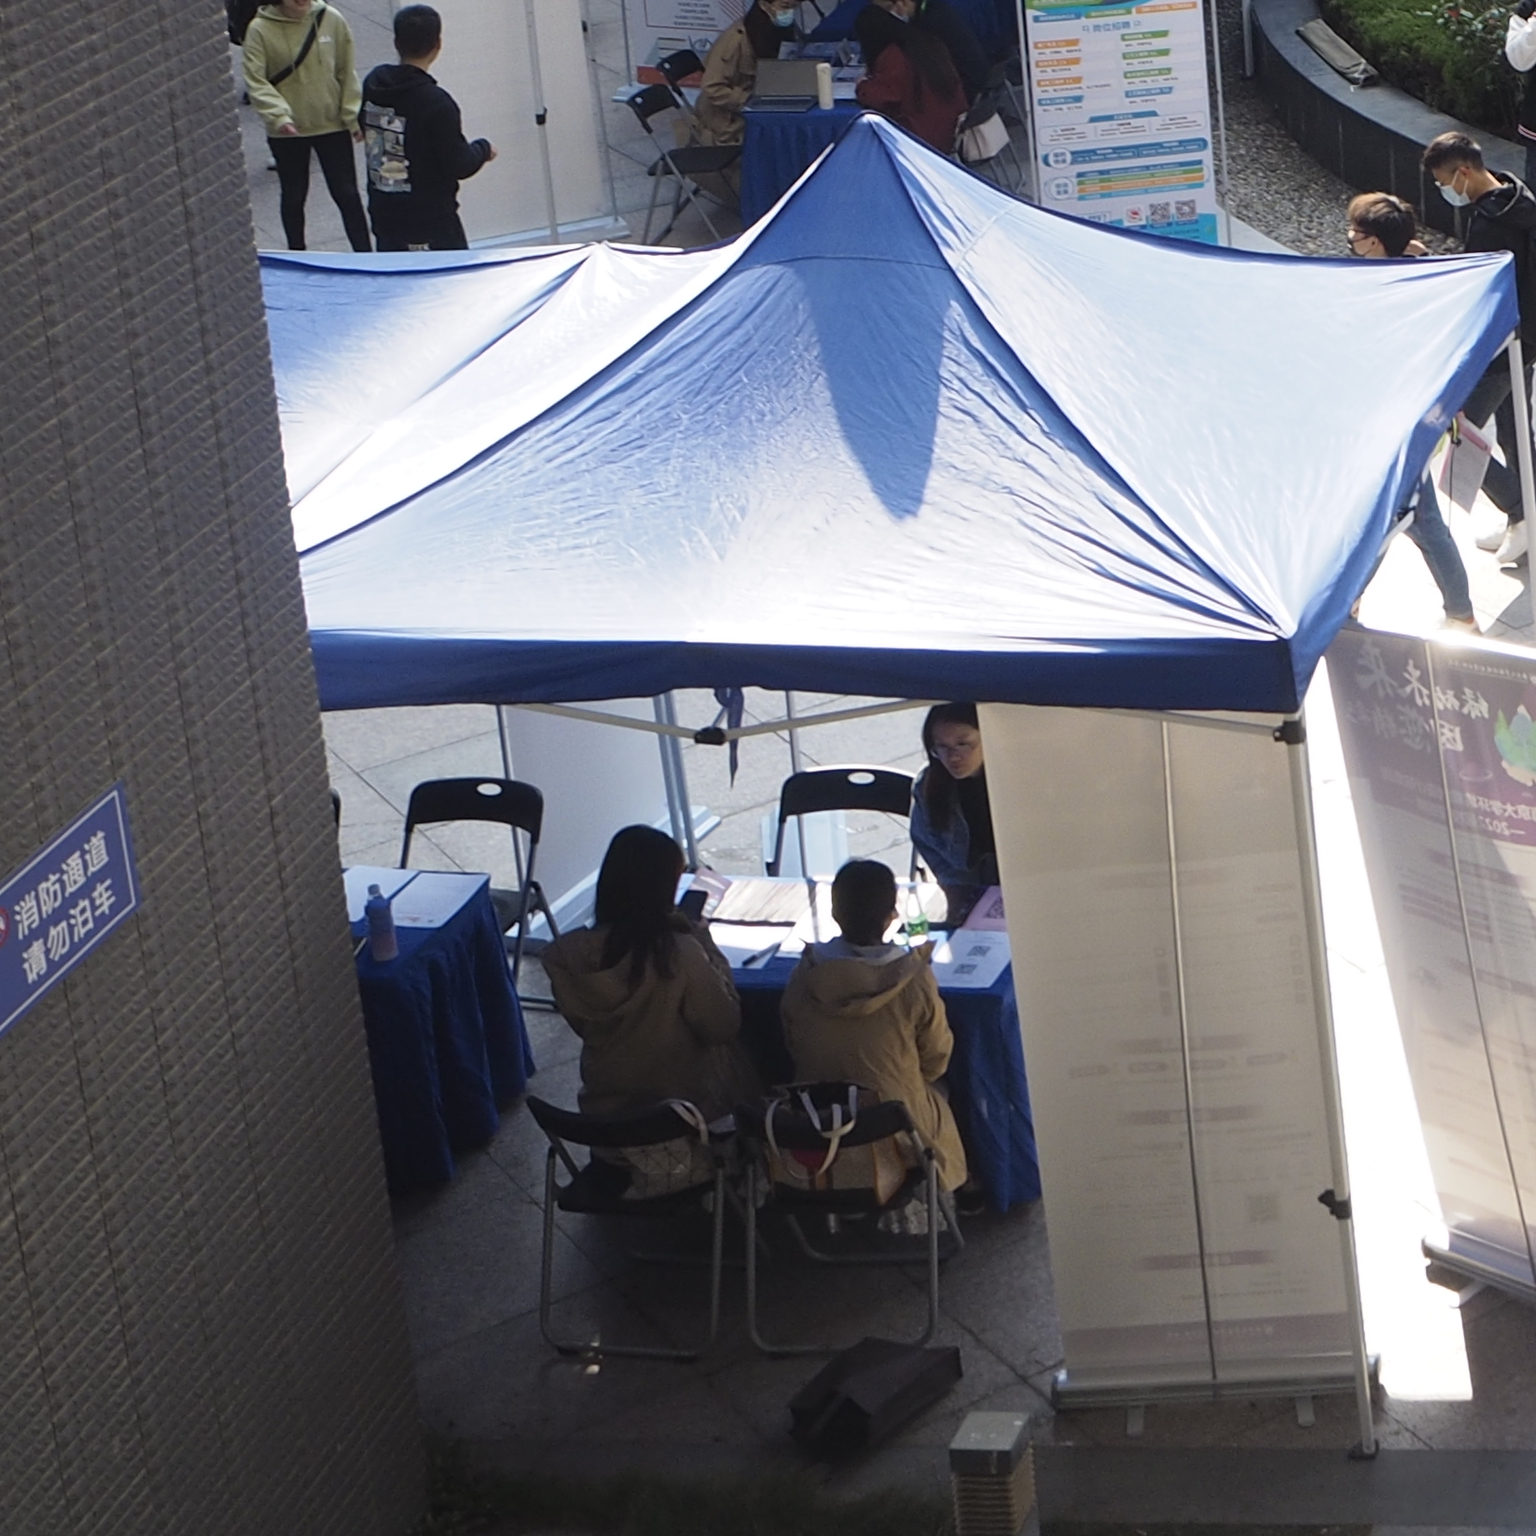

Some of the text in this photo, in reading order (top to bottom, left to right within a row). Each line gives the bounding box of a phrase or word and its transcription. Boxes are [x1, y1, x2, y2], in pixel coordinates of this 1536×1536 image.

[14, 830, 109, 940] 消防通道
[22, 878, 116, 984] 请勿泊车
